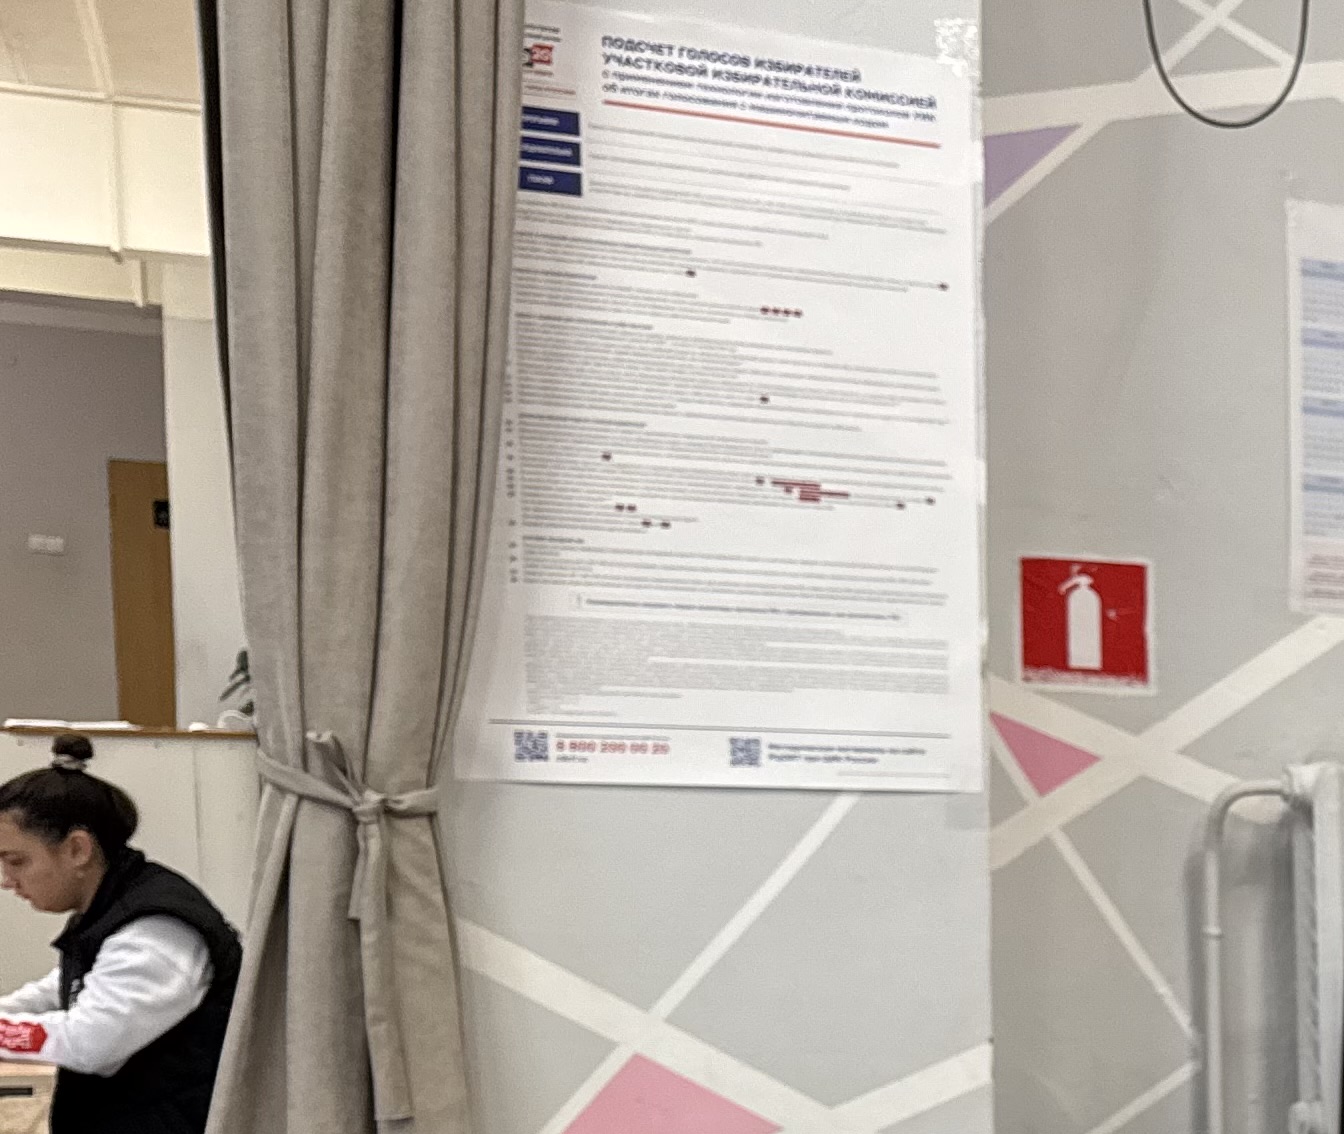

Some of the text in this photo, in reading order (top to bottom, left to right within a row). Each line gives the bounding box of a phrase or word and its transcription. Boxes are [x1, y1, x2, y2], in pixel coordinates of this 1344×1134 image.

[602, 35, 862, 83] ПОДСЧЕТ ГОЛОСОВ ИЗБИРАТЕЛЕЙ
[602, 52, 938, 109] УЧАСТКОВОЙ ИЗБИРАТЕЛЬНОЙ КОМИССИЕЙ
